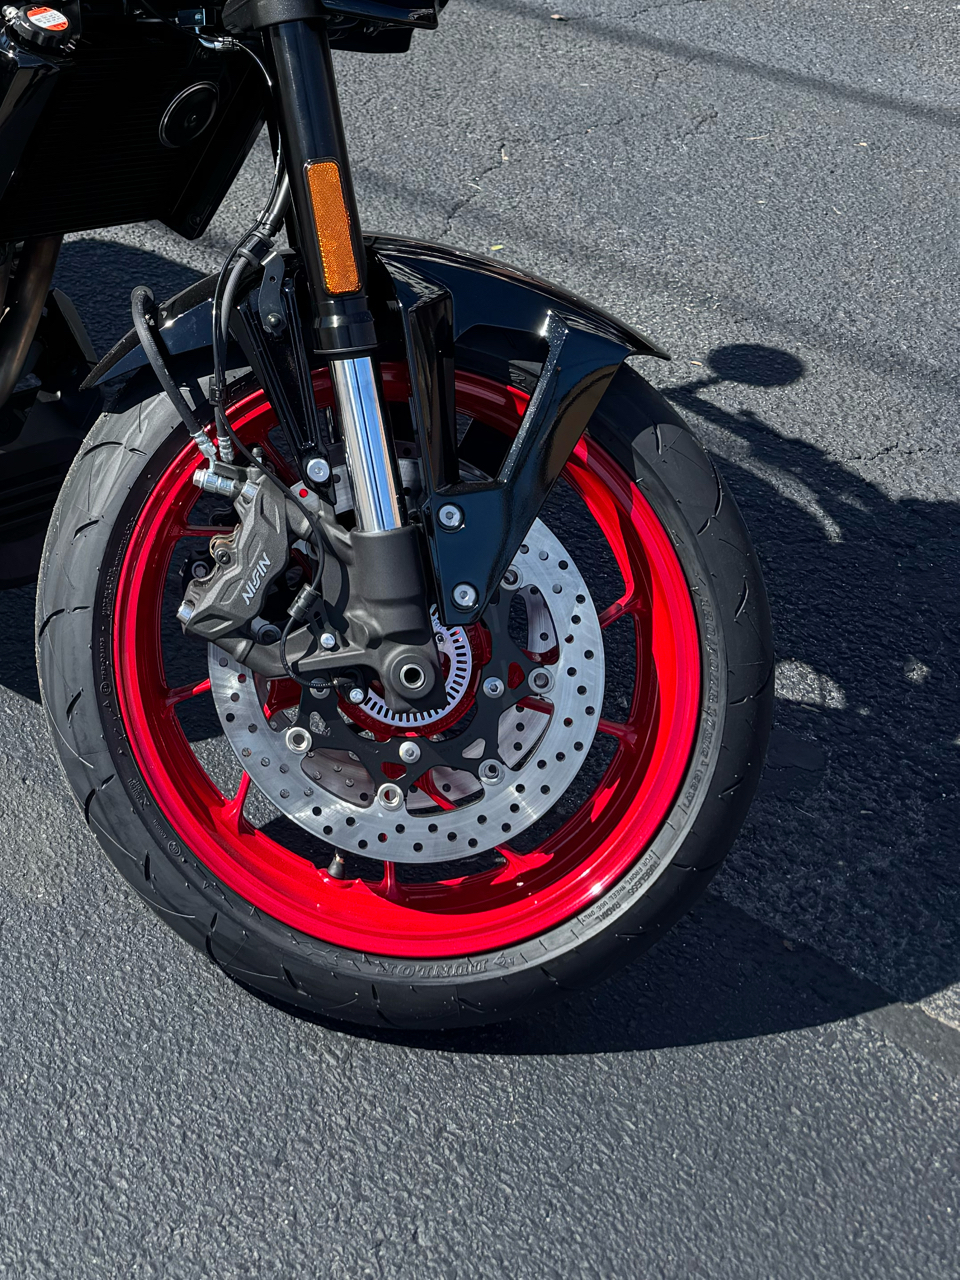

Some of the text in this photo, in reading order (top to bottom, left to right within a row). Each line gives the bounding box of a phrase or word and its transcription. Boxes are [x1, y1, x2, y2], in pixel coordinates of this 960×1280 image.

[581, 854, 654, 923] FOR FRONT WHEEL USE ONLY
[595, 860, 660, 922] TUBELESS RADIAL
[376, 958, 488, 978] DUNLOP
